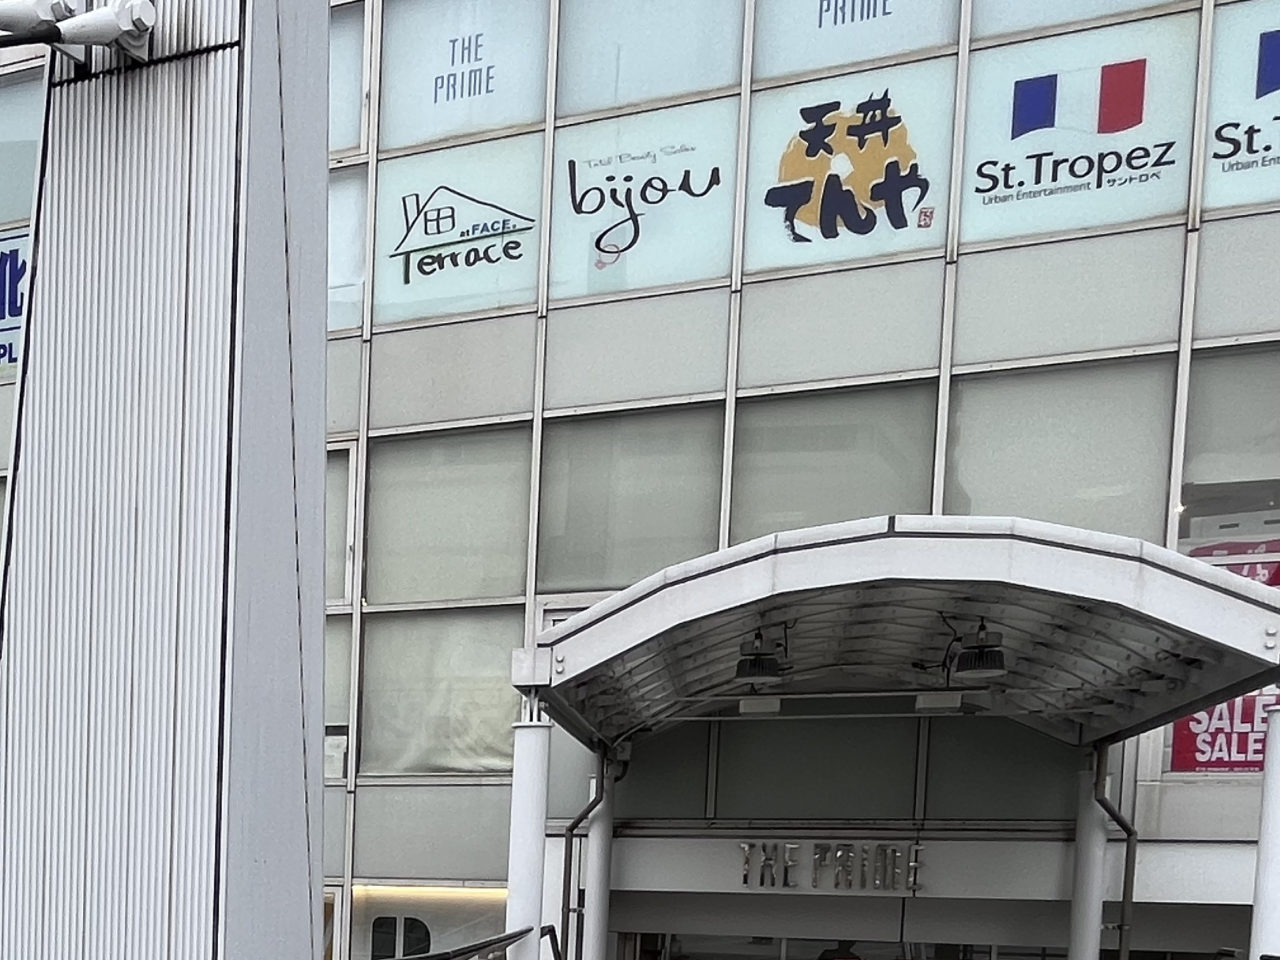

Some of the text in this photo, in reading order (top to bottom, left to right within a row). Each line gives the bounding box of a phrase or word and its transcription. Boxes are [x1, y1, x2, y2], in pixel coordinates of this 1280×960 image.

[818, 0, 893, 29] PRIME
[449, 33, 484, 67] THE
[433, 65, 496, 104] PRIME
[975, 140, 1177, 194] St.Tropez
[1222, 159, 1259, 173] Urban
[567, 158, 722, 254] bijou
[764, 159, 931, 243] てんや
[982, 181, 1091, 206] Urban Entertainment
[400, 239, 523, 285] Terrace
[1188, 696, 1277, 734] SALE
[1195, 732, 1265, 762] SALE
[740, 842, 925, 891] THE PRIME
